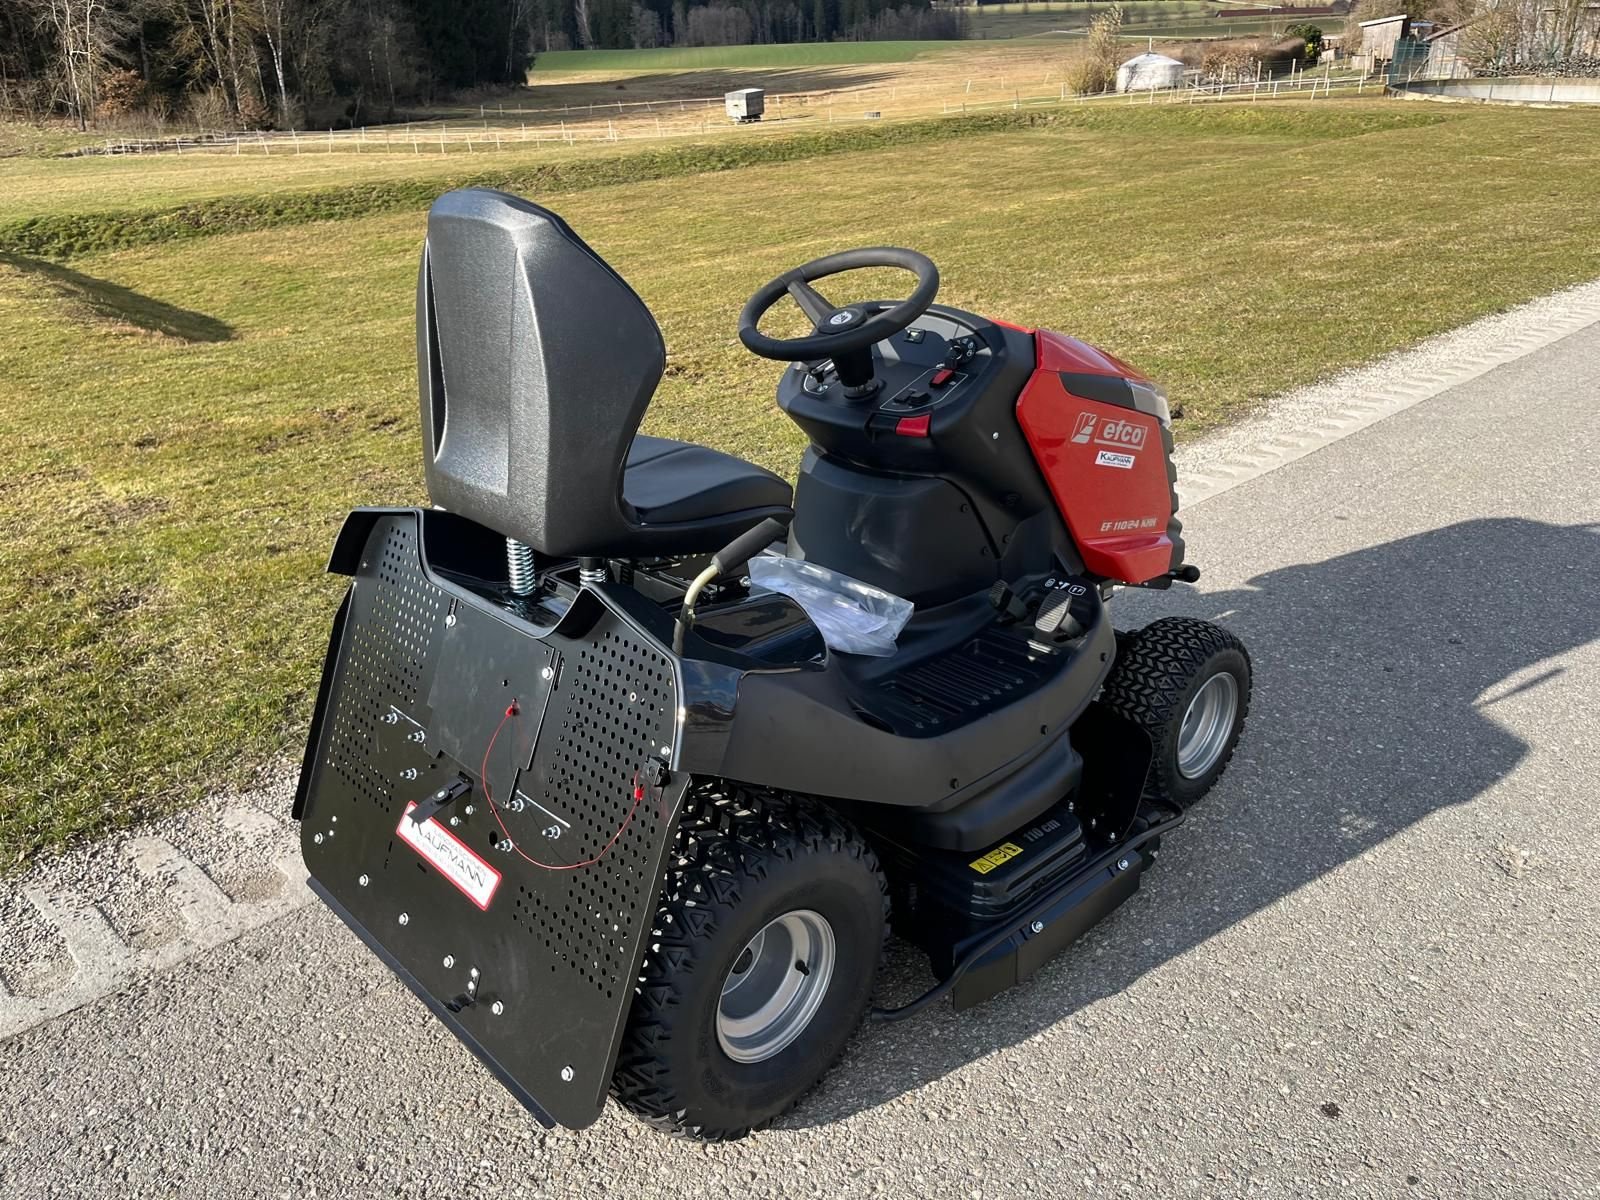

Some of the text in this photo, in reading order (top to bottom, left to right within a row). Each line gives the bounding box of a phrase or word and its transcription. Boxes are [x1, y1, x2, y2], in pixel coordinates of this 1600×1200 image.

[1103, 420, 1142, 443] efco
[1100, 521, 1112, 532] EF
[1023, 827, 1045, 842] 110
